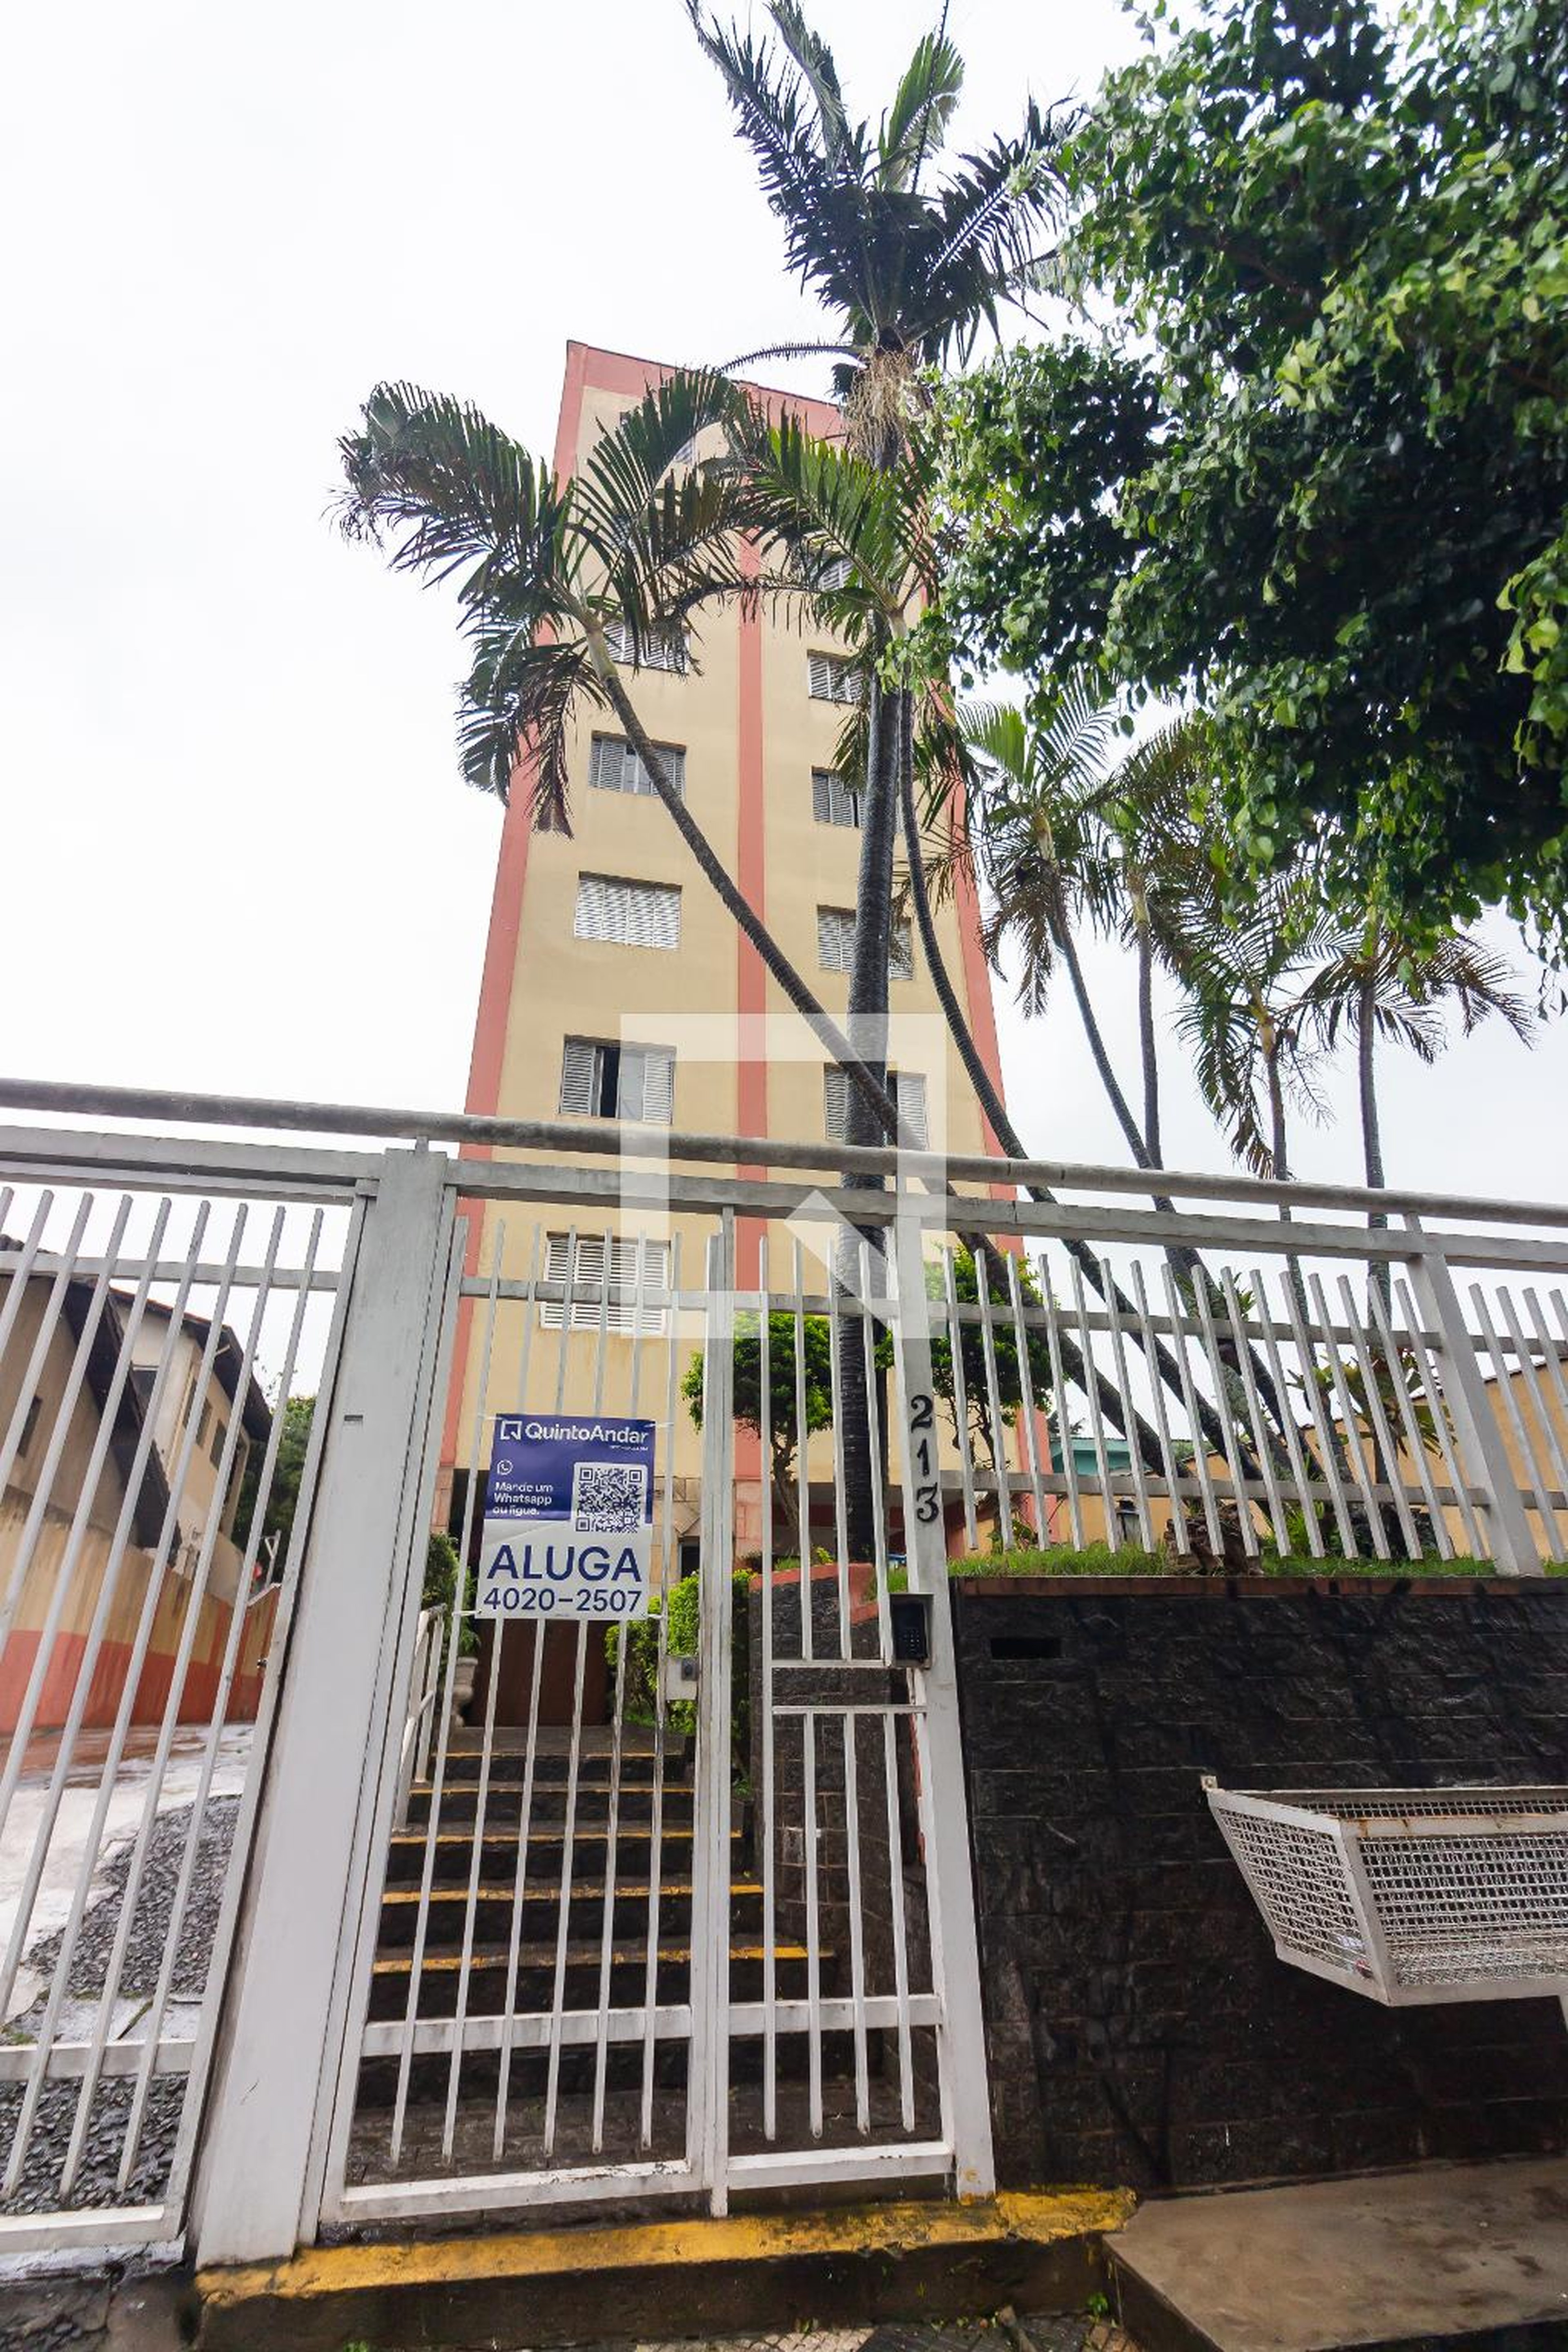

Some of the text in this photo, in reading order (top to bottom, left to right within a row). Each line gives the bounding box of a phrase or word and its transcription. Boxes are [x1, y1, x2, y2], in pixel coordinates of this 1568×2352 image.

[525, 1422, 648, 1444] QuintoAndar
[911, 1394, 938, 1522] 213
[495, 1482, 533, 1492] Mande
[494, 1493, 552, 1506] Whatsapp
[487, 1545, 641, 1582] ALUGA
[484, 1588, 642, 1612] 4020-2507
